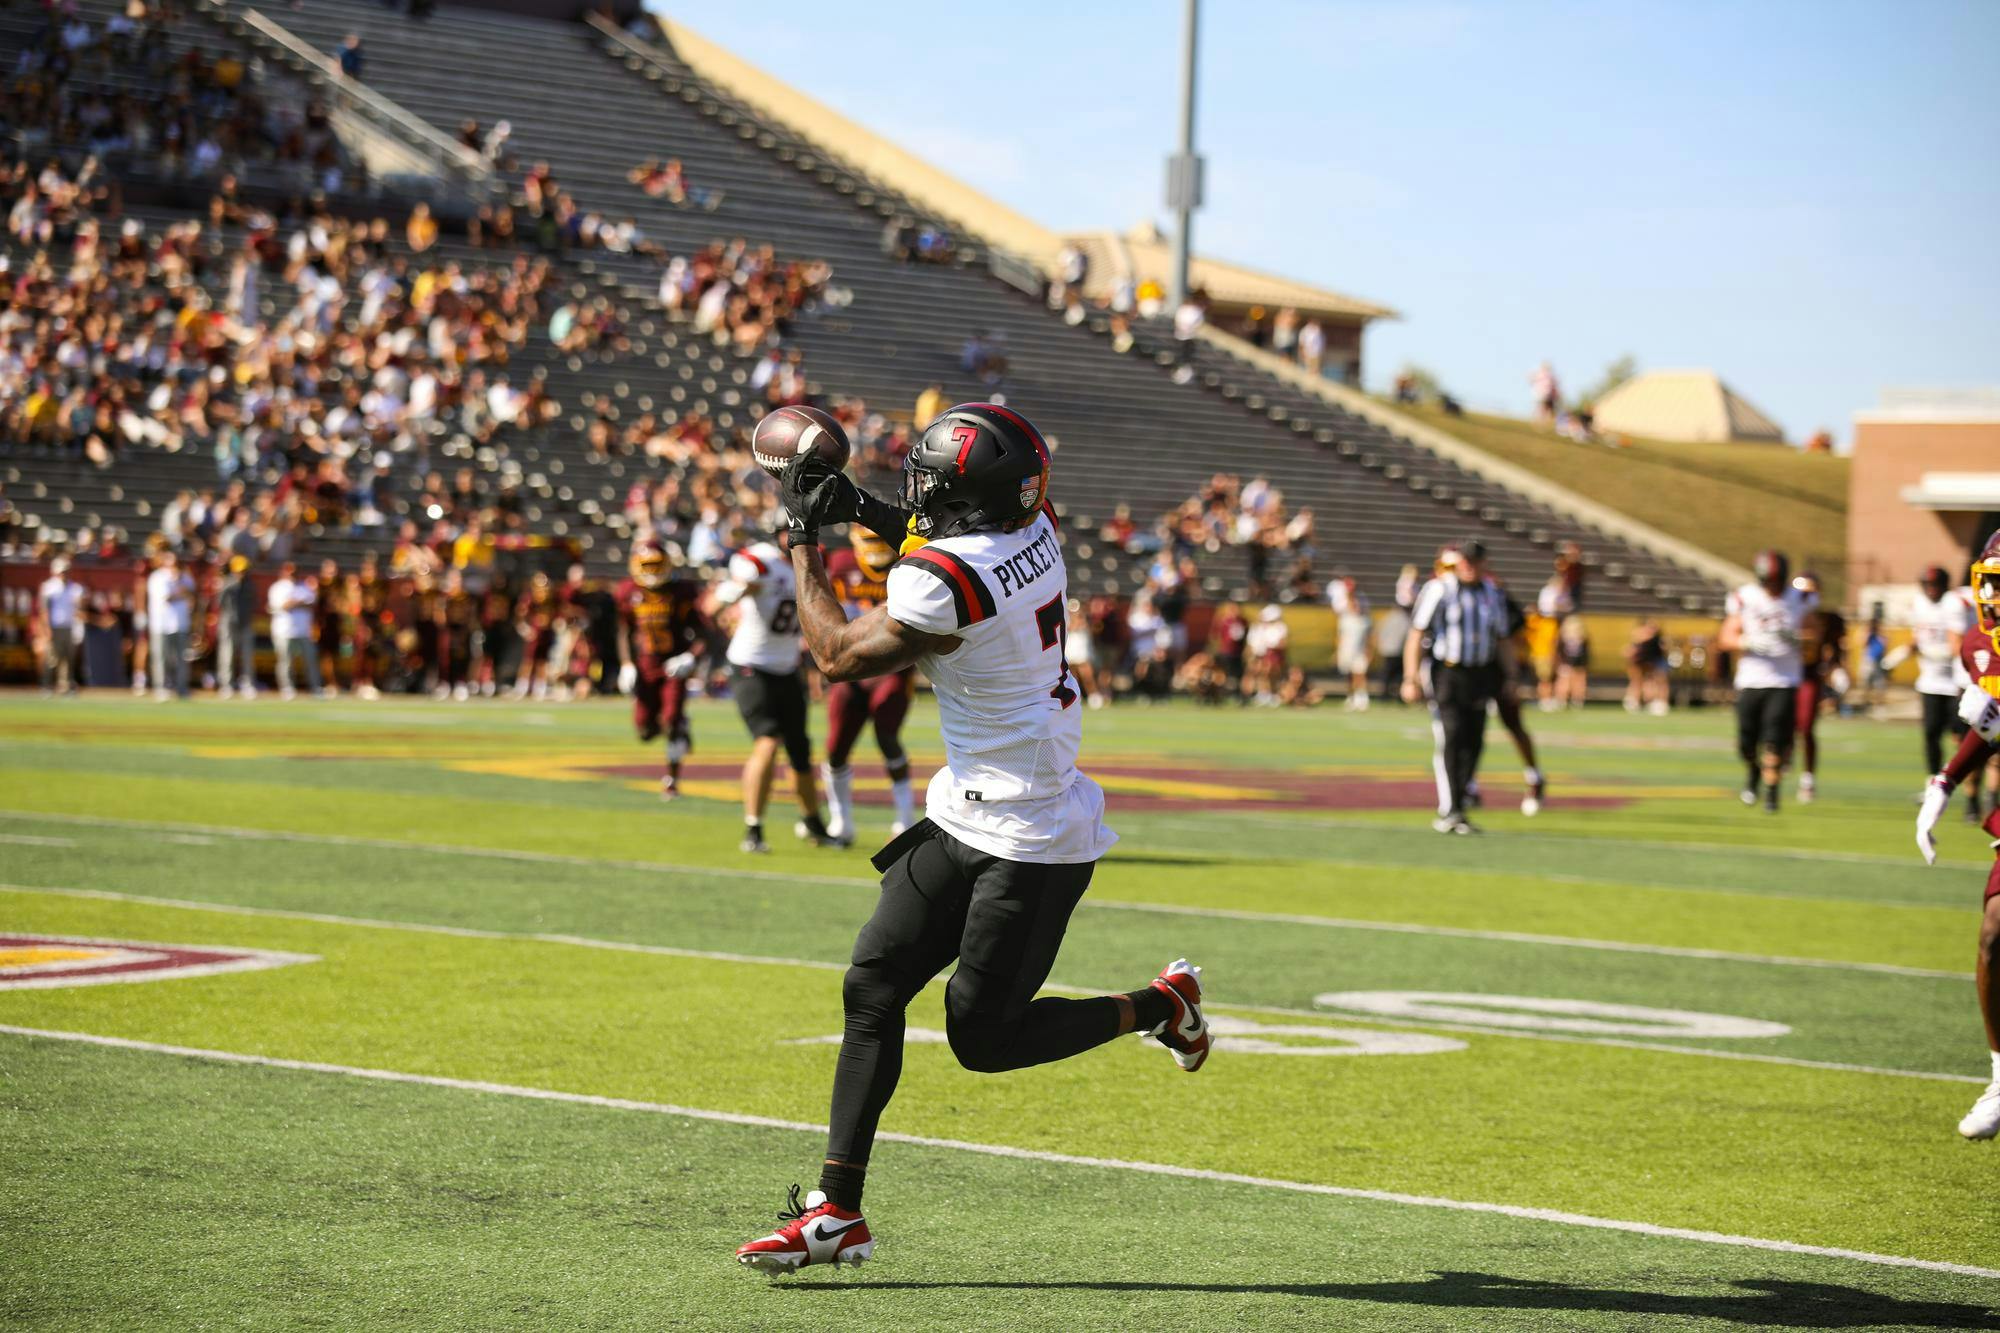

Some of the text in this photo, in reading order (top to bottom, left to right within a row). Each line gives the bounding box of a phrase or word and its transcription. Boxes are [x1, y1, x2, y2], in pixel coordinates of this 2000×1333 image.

[951, 426, 978, 476] 7
[992, 527, 1059, 599] PICKETT
[771, 598, 801, 635] 8
[1035, 590, 1077, 710] 7
